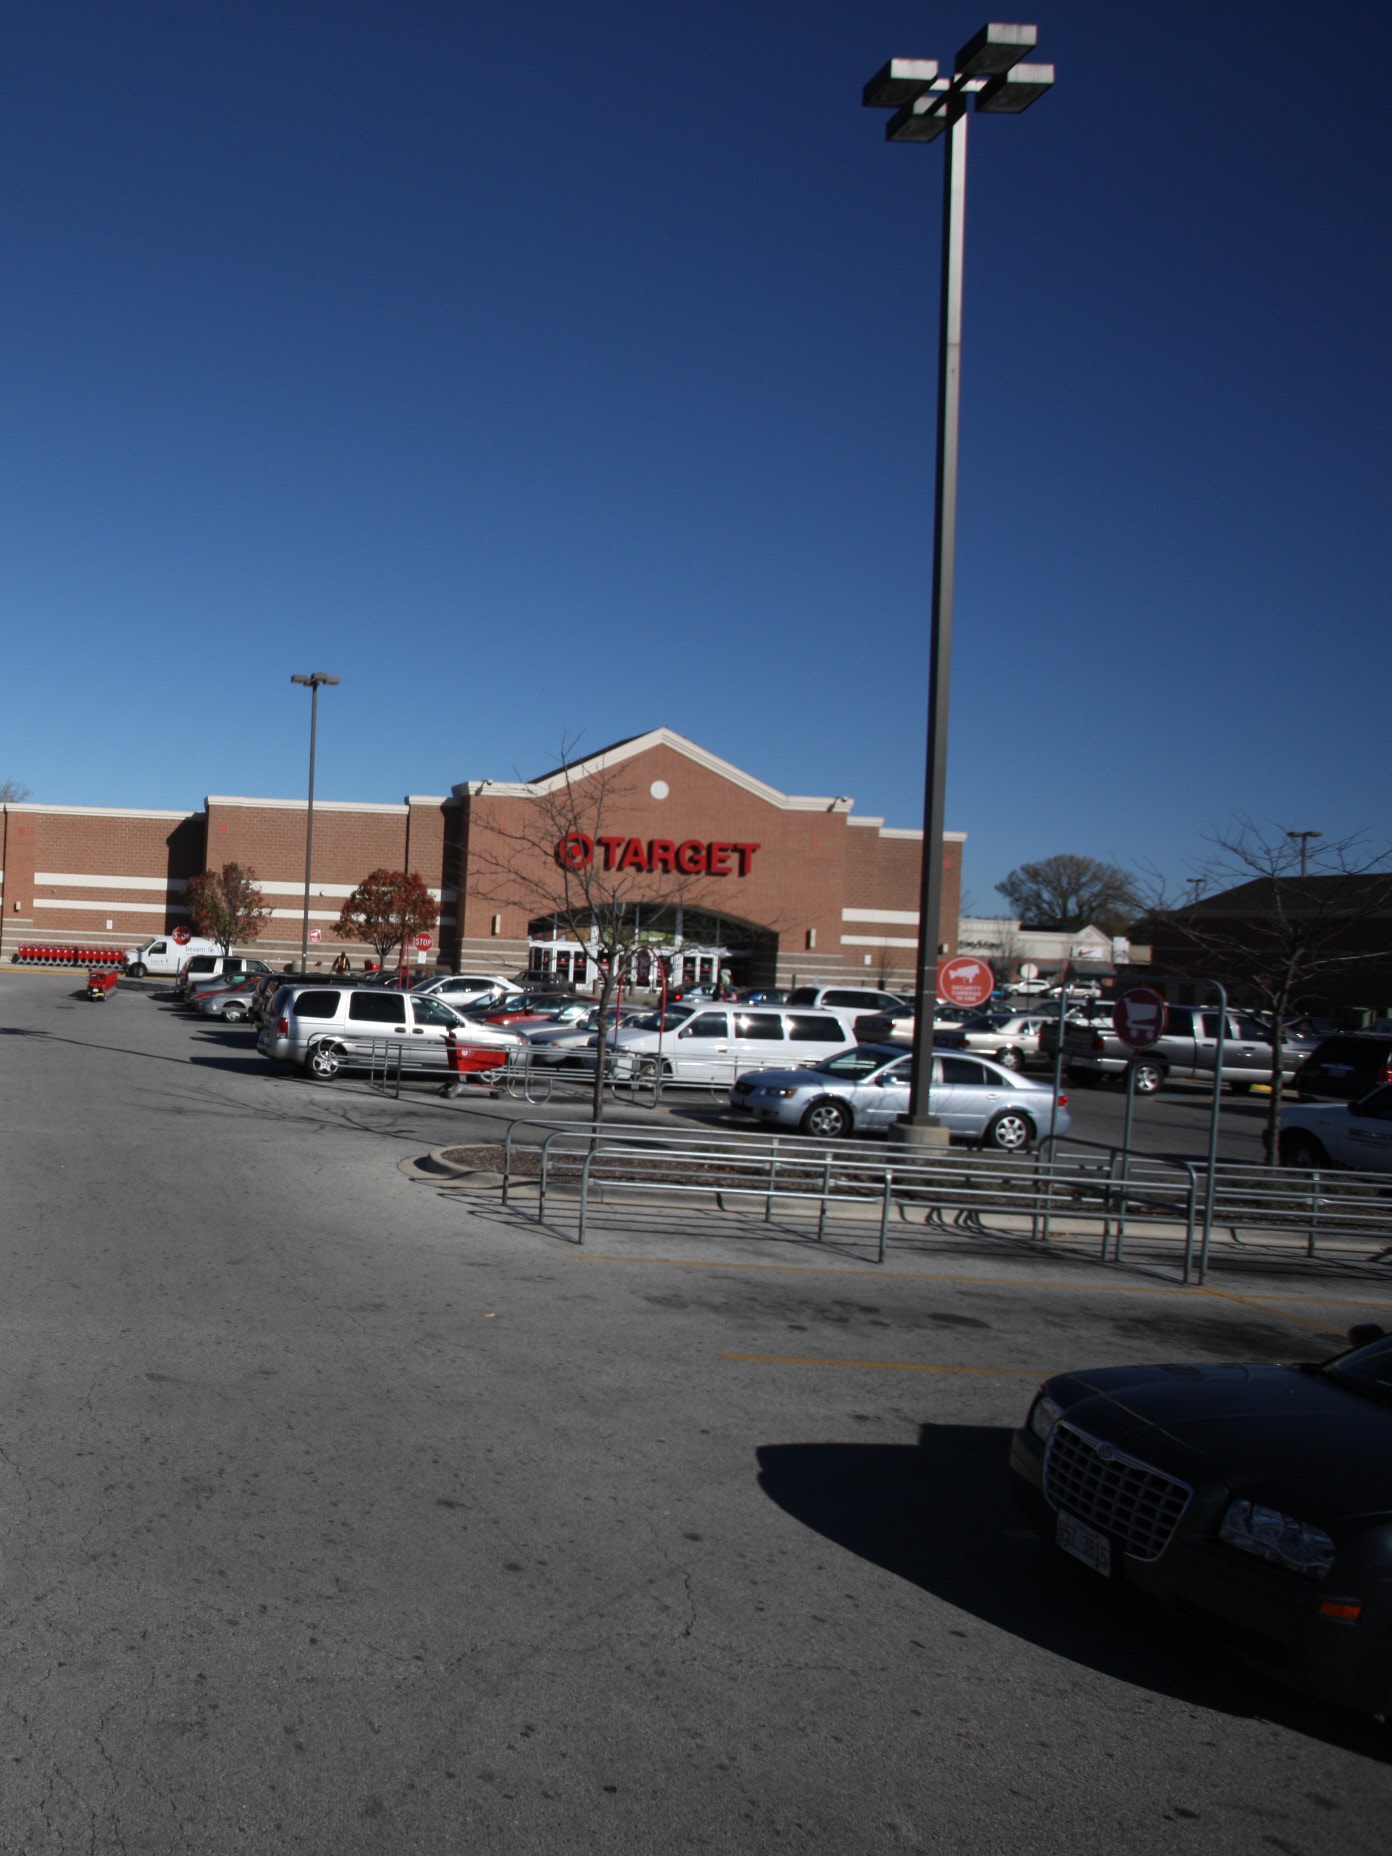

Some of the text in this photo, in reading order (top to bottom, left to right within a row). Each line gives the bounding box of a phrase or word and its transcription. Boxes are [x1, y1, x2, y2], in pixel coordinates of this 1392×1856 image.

[596, 836, 761, 877] TARGET
[173, 931, 191, 941] STOP
[415, 937, 433, 946] STOP
[185, 945, 206, 953] besam
